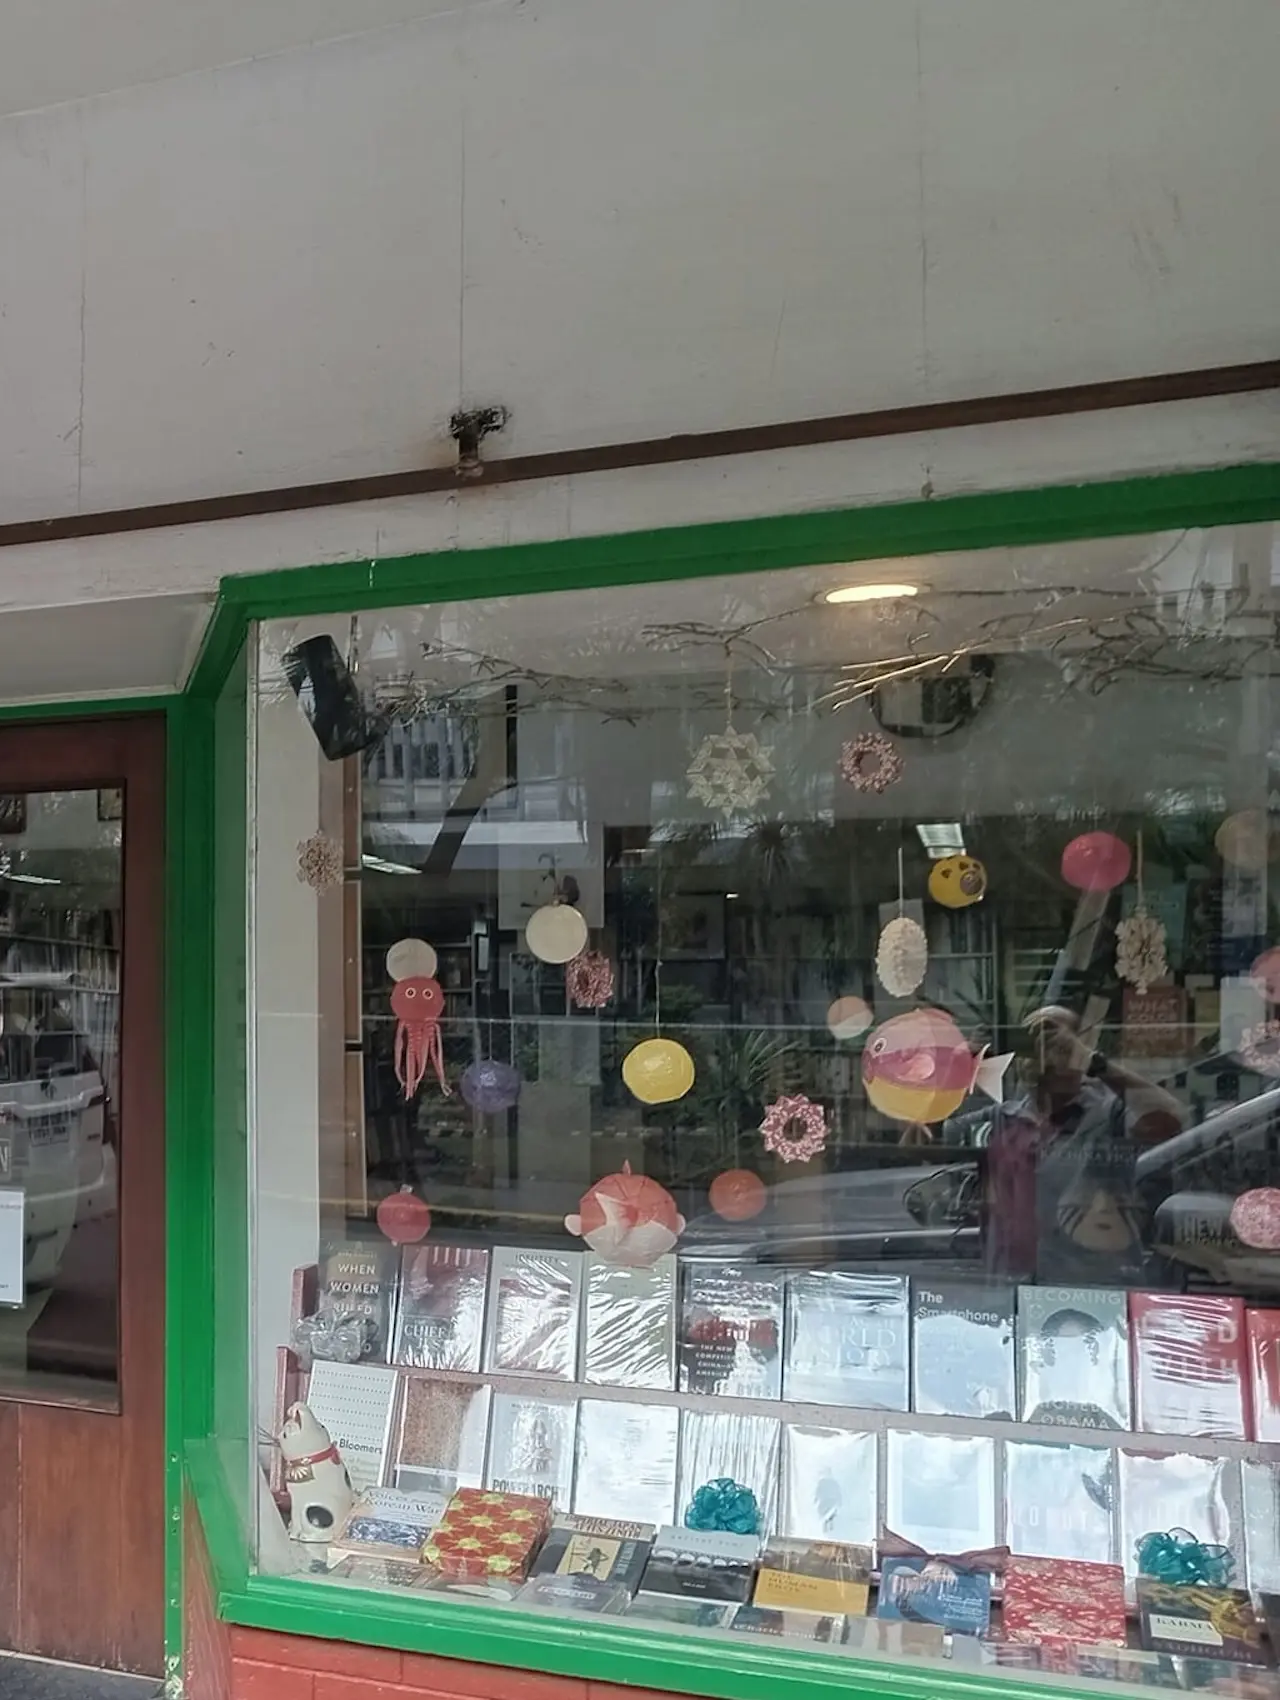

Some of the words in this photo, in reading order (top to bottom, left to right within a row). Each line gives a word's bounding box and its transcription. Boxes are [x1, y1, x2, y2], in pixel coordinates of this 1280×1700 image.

[337, 1263, 376, 1275] WHEN
[330, 1280, 379, 1294] WOMEN
[918, 1291, 944, 1304] The
[1023, 1288, 1122, 1304] BECOMING
[404, 1323, 447, 1338] CHIEF
[363, 1497, 411, 1511] Korean
[415, 1502, 441, 1515] War
